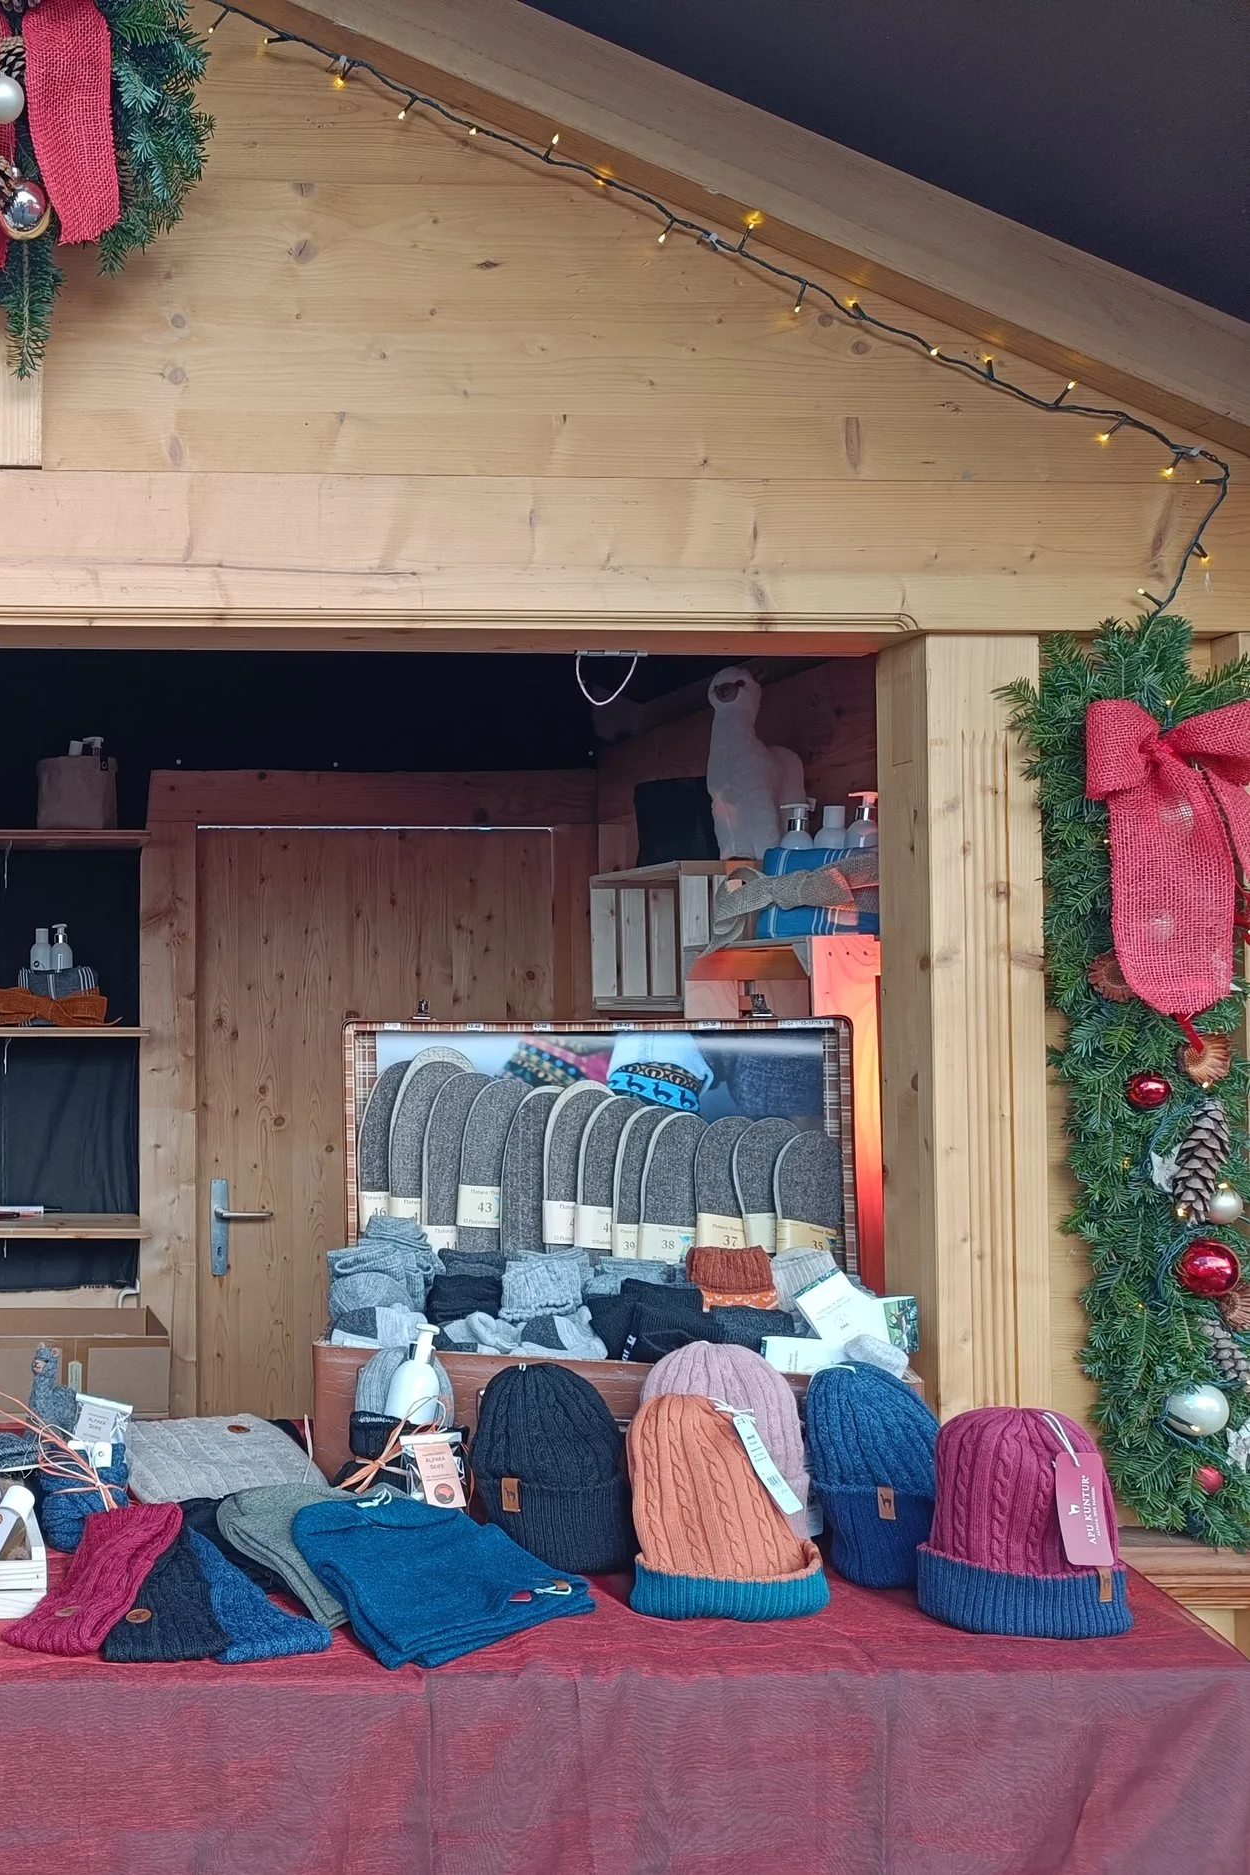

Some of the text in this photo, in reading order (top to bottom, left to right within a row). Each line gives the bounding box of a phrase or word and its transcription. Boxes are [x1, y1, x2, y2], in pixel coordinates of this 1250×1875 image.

[477, 1202, 493, 1213] 43
[623, 1241, 636, 1251] 39
[661, 1239, 675, 1250] 38
[722, 1234, 738, 1248] 37
[811, 1240, 824, 1250] 35
[87, 1416, 107, 1425] ALPAKA
[425, 1455, 446, 1464] ALPAKA
[1087, 1524, 1097, 1545] APU
